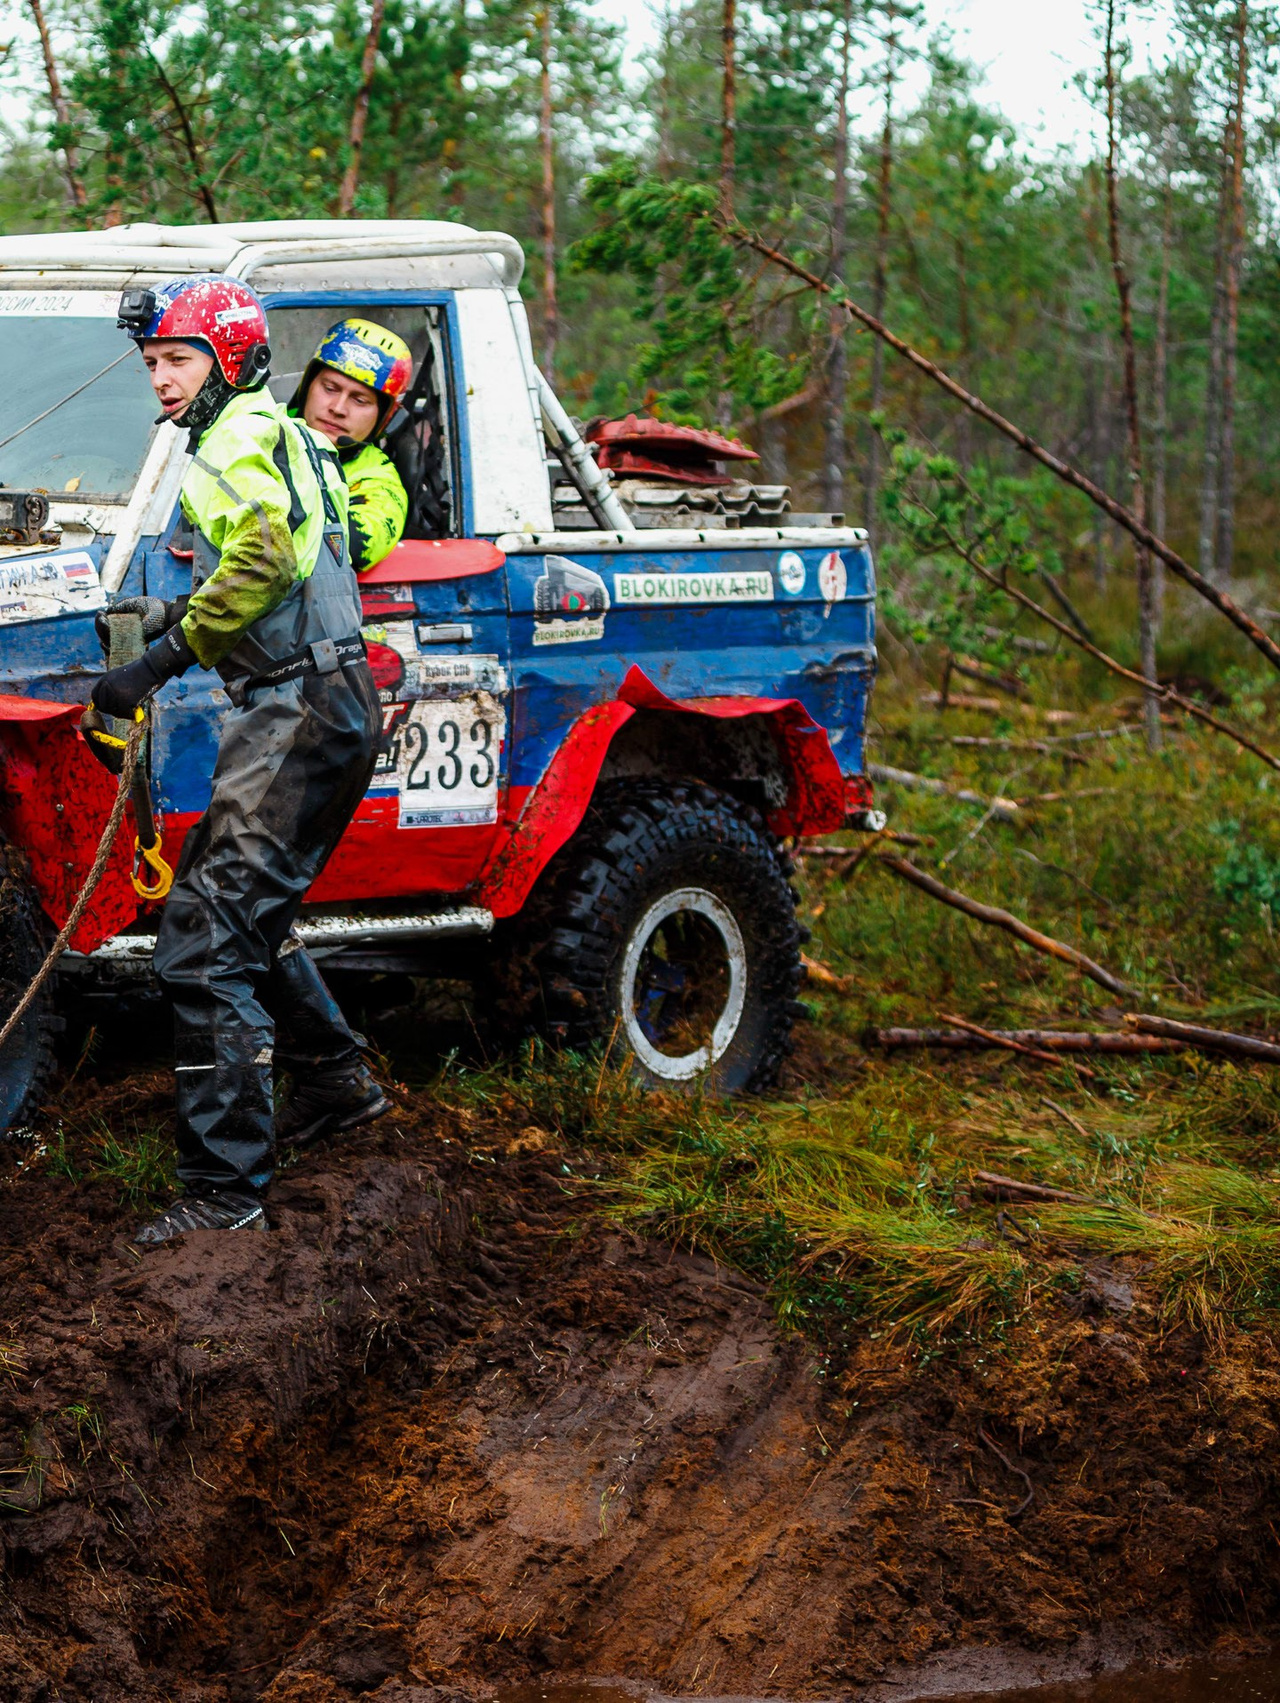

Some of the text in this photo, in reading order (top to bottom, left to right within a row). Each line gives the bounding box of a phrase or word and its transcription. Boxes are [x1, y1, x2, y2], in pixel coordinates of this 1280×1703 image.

[35, 296, 74, 312] 2024
[620, 576, 769, 599] BLOKIROVKA.RU
[535, 625, 601, 642] BLOKIROVKA.RU
[405, 718, 494, 790] 233
[229, 1207, 263, 1230] ALOMON
